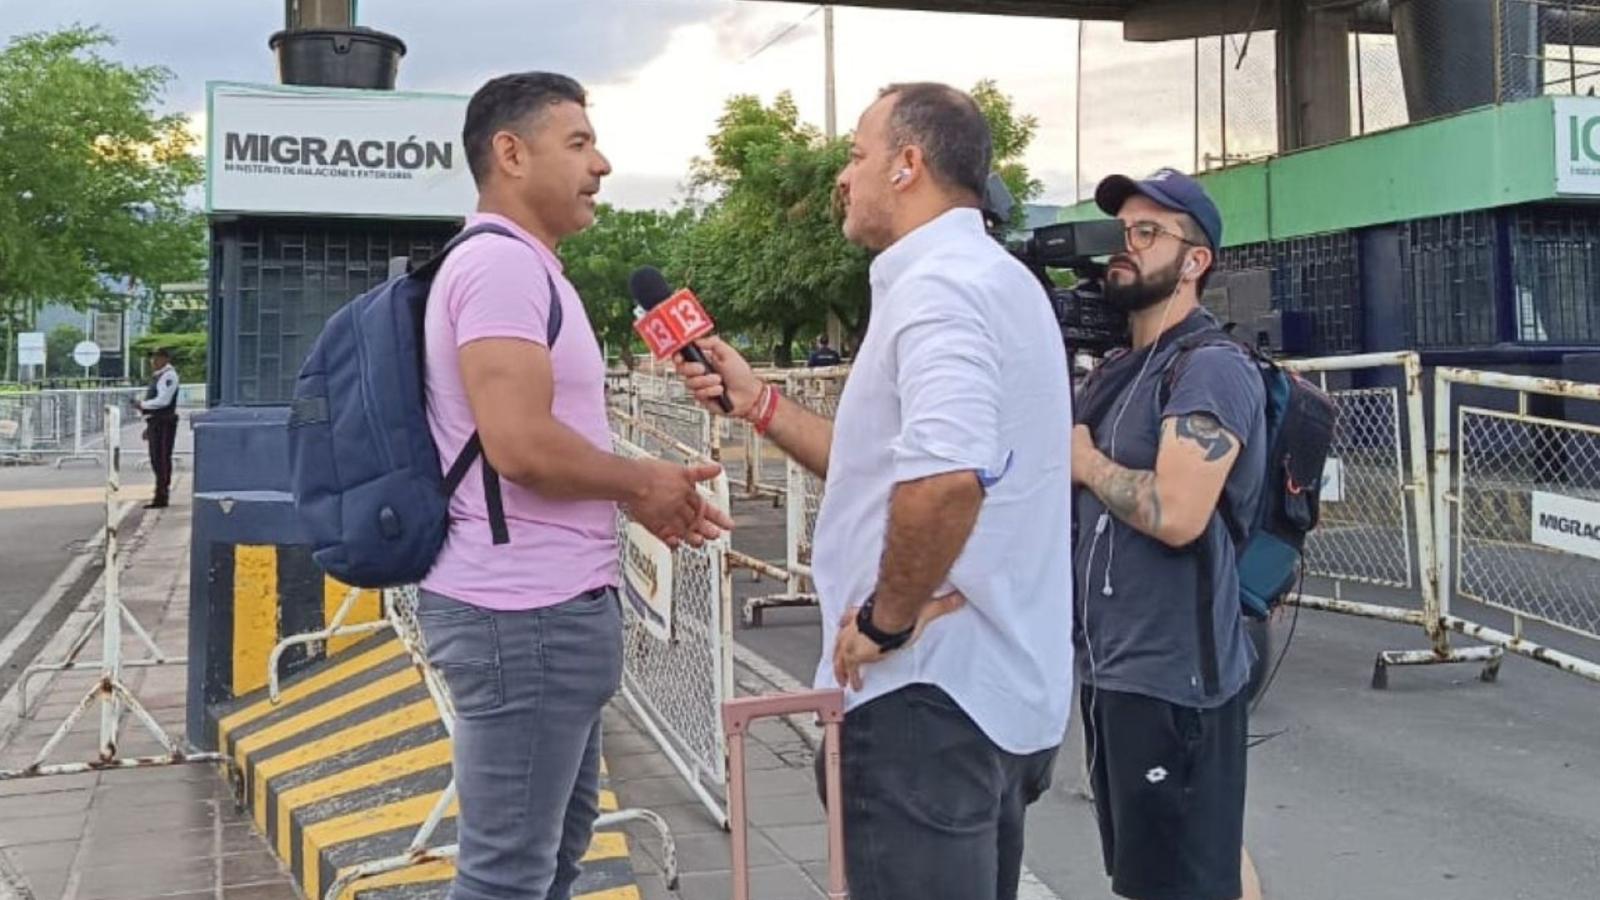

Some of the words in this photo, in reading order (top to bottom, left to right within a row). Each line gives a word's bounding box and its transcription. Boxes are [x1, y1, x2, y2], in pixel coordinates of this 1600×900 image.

[225, 132, 452, 170] MIGRACIÓN
[642, 318, 678, 355] 13
[669, 299, 707, 337] 13
